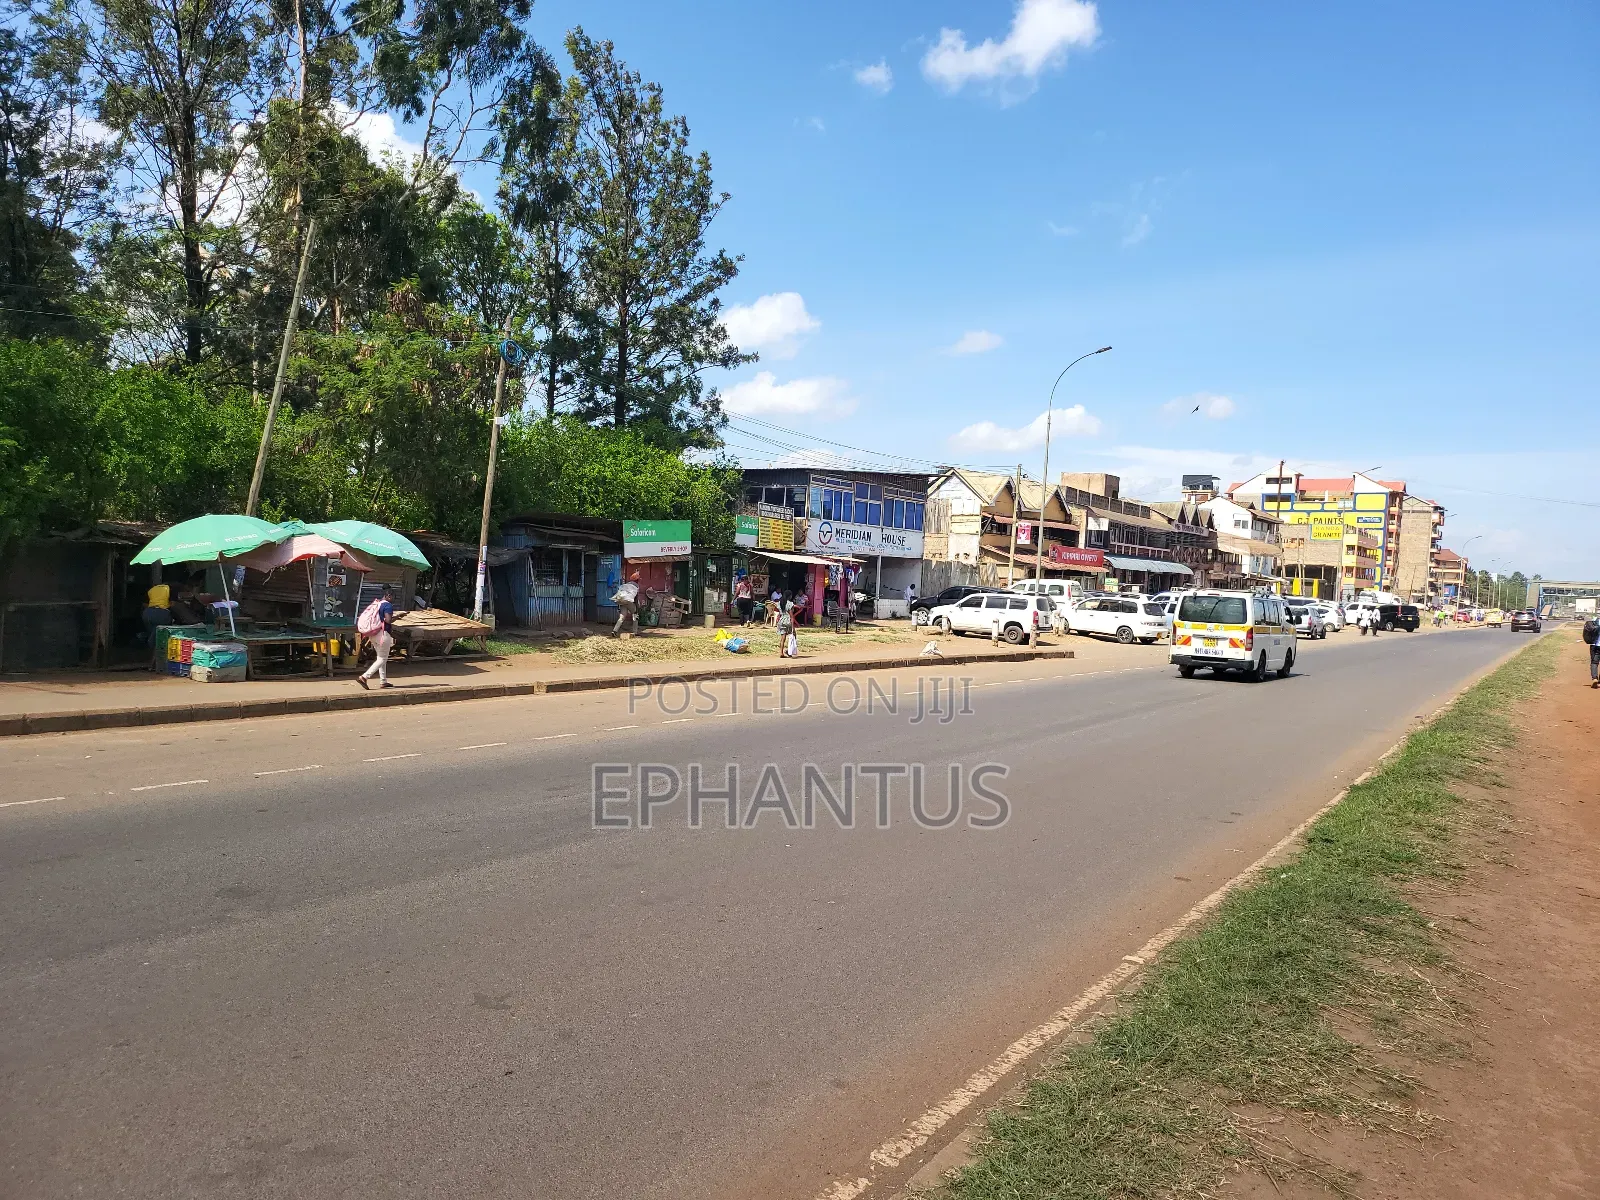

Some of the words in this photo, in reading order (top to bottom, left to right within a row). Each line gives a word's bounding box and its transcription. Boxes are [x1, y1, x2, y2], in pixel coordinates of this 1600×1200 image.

[741, 521, 759, 530] Safarico
[1313, 517, 1344, 525] PAINTS
[630, 527, 657, 537] Safaricom
[834, 527, 872, 542] MERIDIAN
[881, 533, 907, 547] HOUSE
